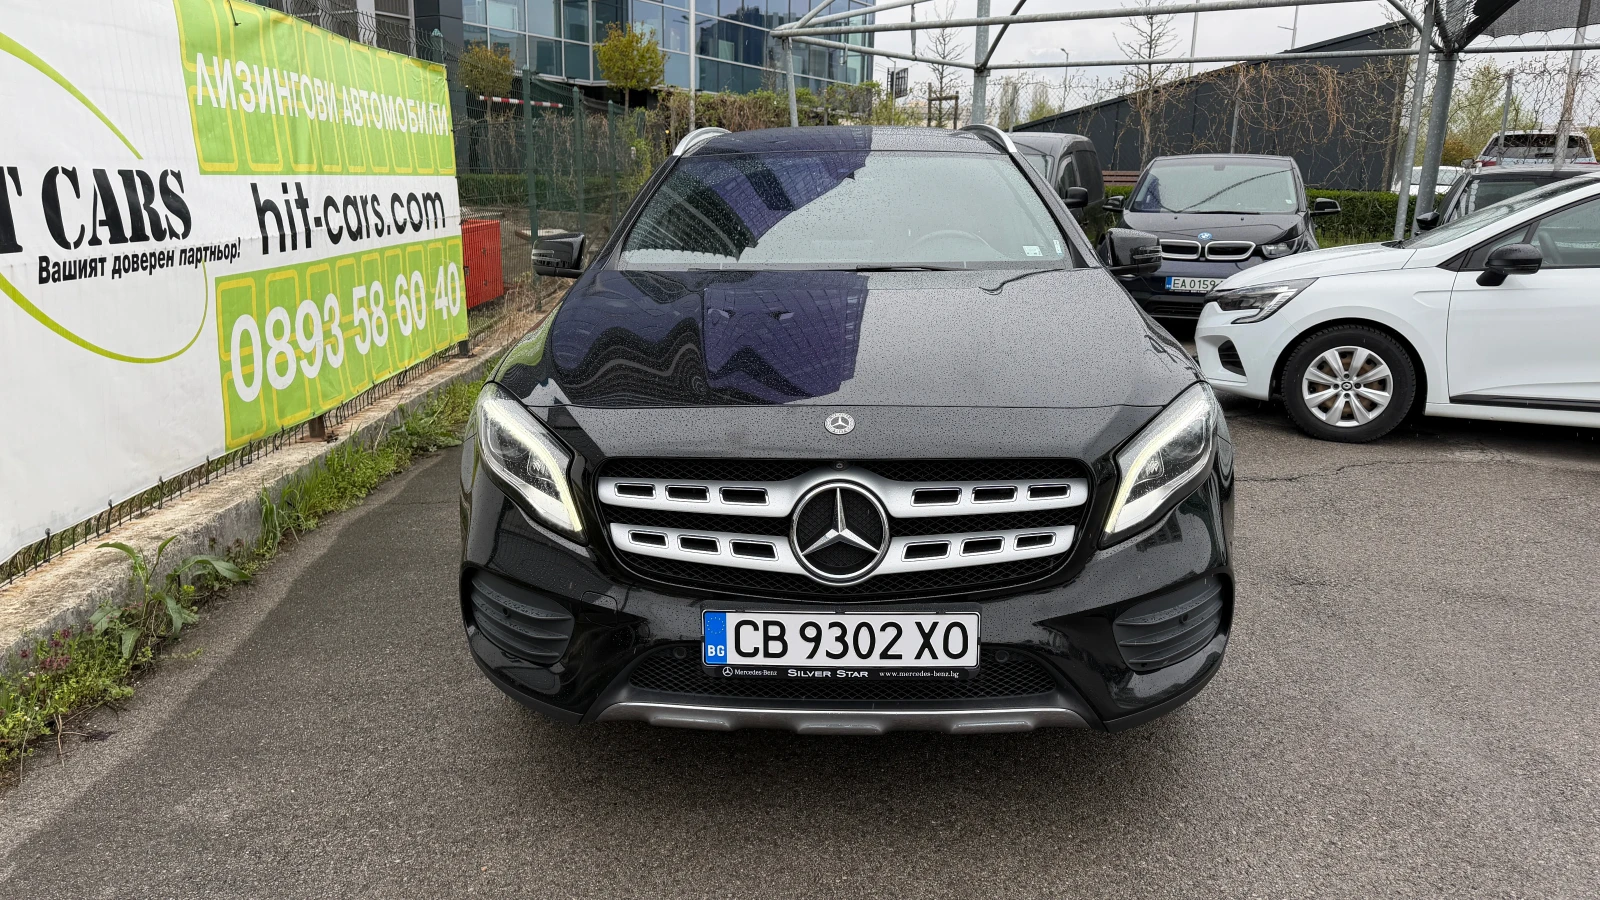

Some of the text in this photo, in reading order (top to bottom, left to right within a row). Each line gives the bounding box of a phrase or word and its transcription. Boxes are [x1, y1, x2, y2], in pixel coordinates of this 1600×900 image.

[196, 52, 449, 137] ЛИЗИНГОВИ АВТОМОБИЛИ
[41, 166, 192, 250] CARS
[250, 182, 446, 255] hit-cars.com
[38, 237, 241, 285] Вашият доверен партньор!
[231, 262, 461, 402] 0893 58 60 40
[707, 644, 725, 657] BG
[734, 619, 969, 660] CB 9302 XO
[734, 669, 778, 677] Mercedes-Benz
[787, 669, 869, 678] SILVER STAR
[879, 670, 960, 679] www.mercedes-benz.bg
